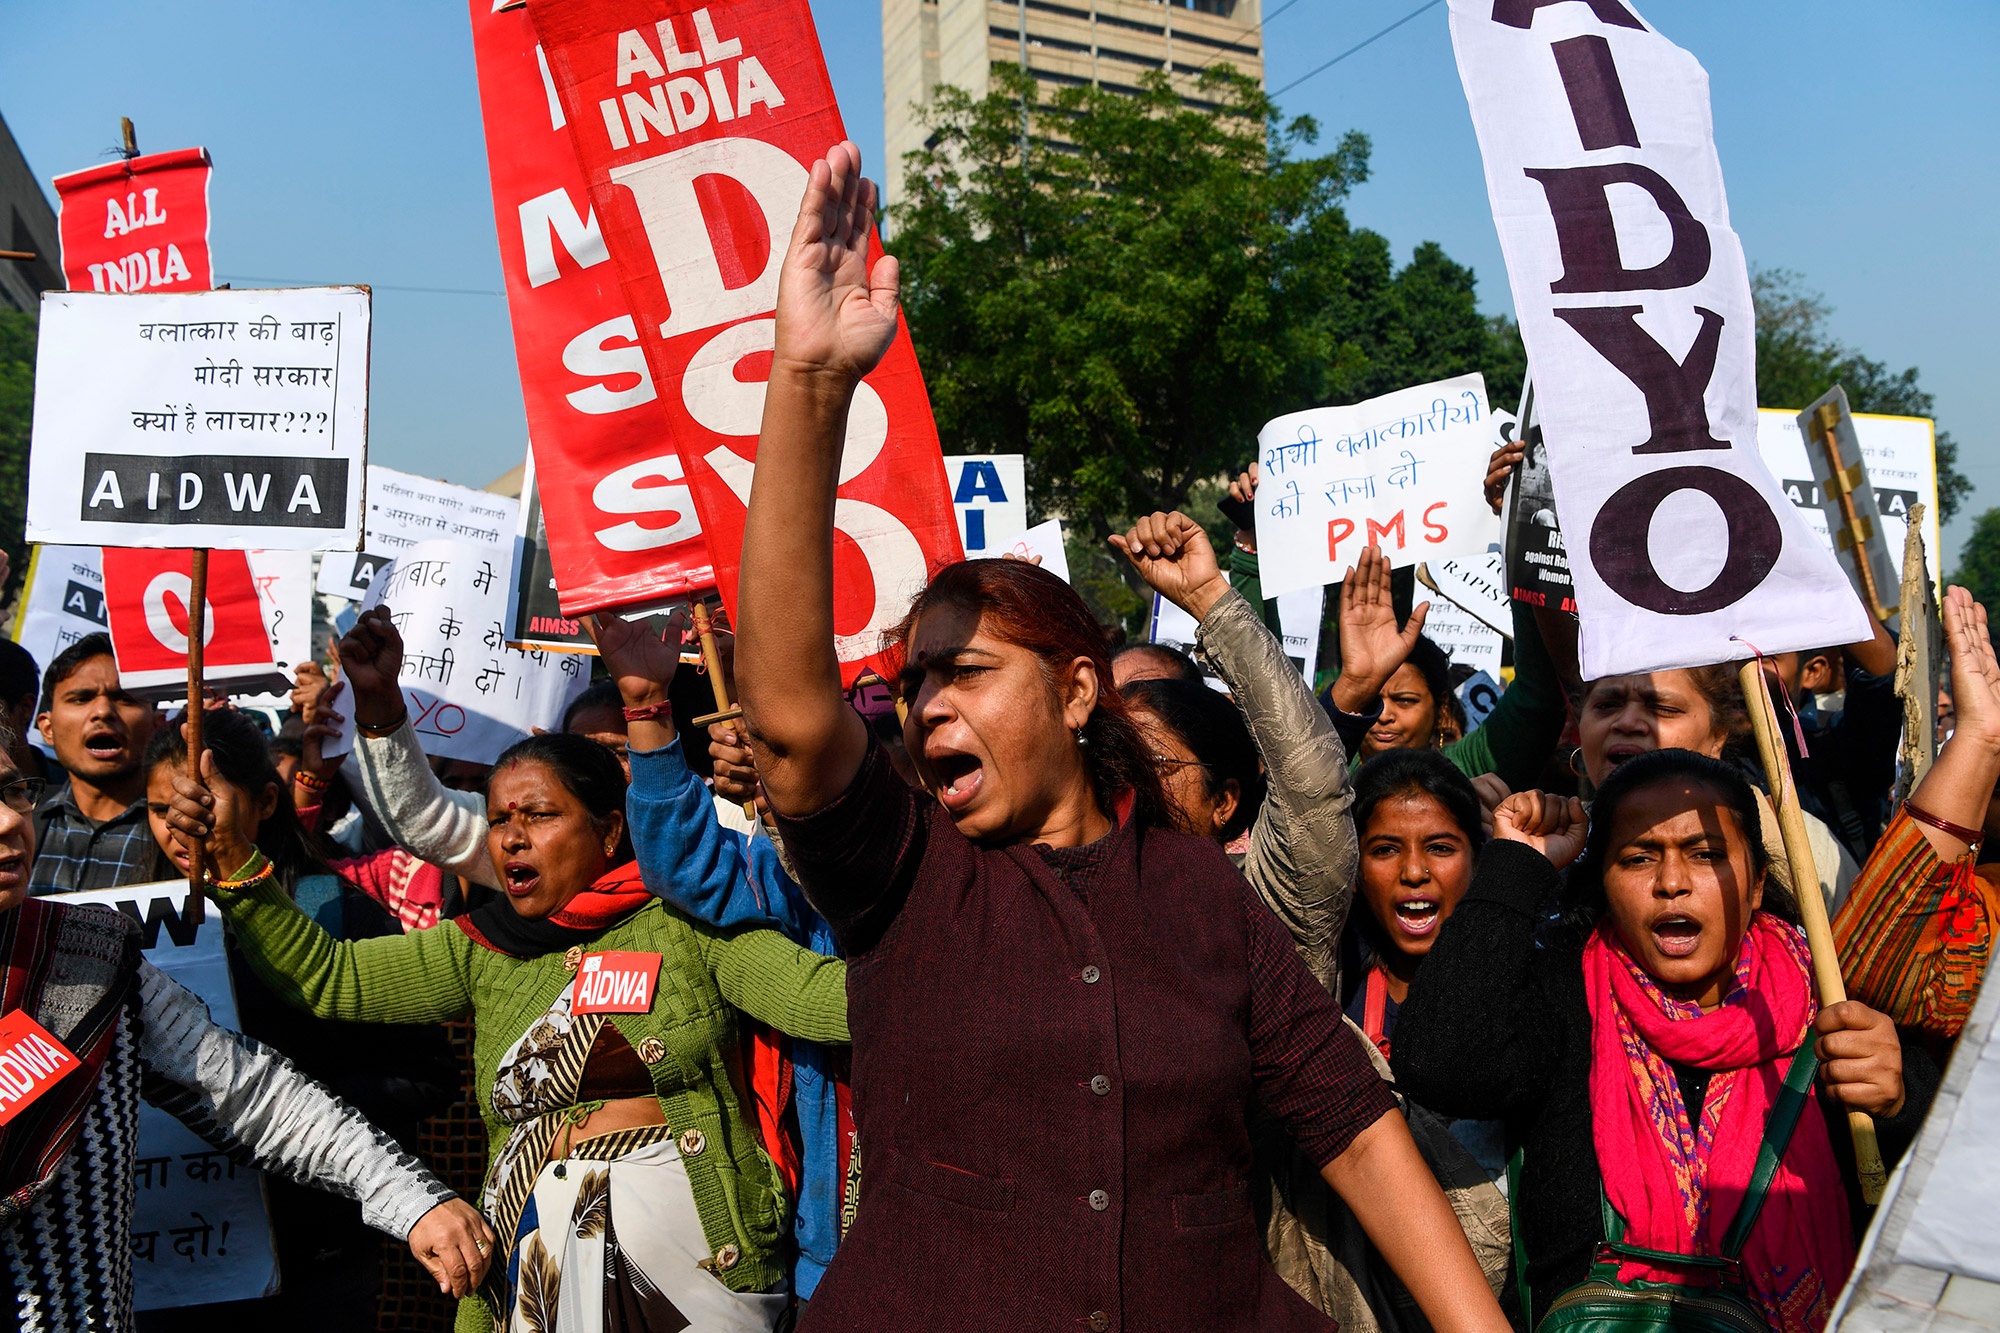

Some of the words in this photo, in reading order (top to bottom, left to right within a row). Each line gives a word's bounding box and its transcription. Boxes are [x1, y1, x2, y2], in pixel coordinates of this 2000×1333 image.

[616, 7, 743, 87] ALL
[599, 56, 786, 150] INDIA
[103, 188, 167, 239] ALL
[87, 243, 192, 293] INDIA
[1491, 0, 1782, 615] IDYO
[139, 321, 239, 342] बलात्कार
[248, 315, 281, 341] की
[290, 321, 336, 347] बाढ़
[194, 357, 243, 388] मोदी
[252, 366, 333, 388] सरकार
[131, 404, 178, 432] क्यों
[184, 403, 197, 434] है
[205, 411, 328, 433] लाचार???
[1264, 424, 1323, 477] सभी
[1271, 480, 1305, 519] को
[1387, 450, 1426, 489] दो
[436, 514, 448, 532] से
[1327, 501, 1449, 562] PMS
[1525, 551, 1553, 566] against
[1538, 568, 1570, 585] Women
[473, 561, 498, 595] में
[1443, 560, 1513, 612] RAPIST
[1513, 587, 1546, 607] AIMSS
[439, 606, 464, 641] के
[529, 616, 580, 636] AIMSS
[577, 970, 648, 1008] AIDWA
